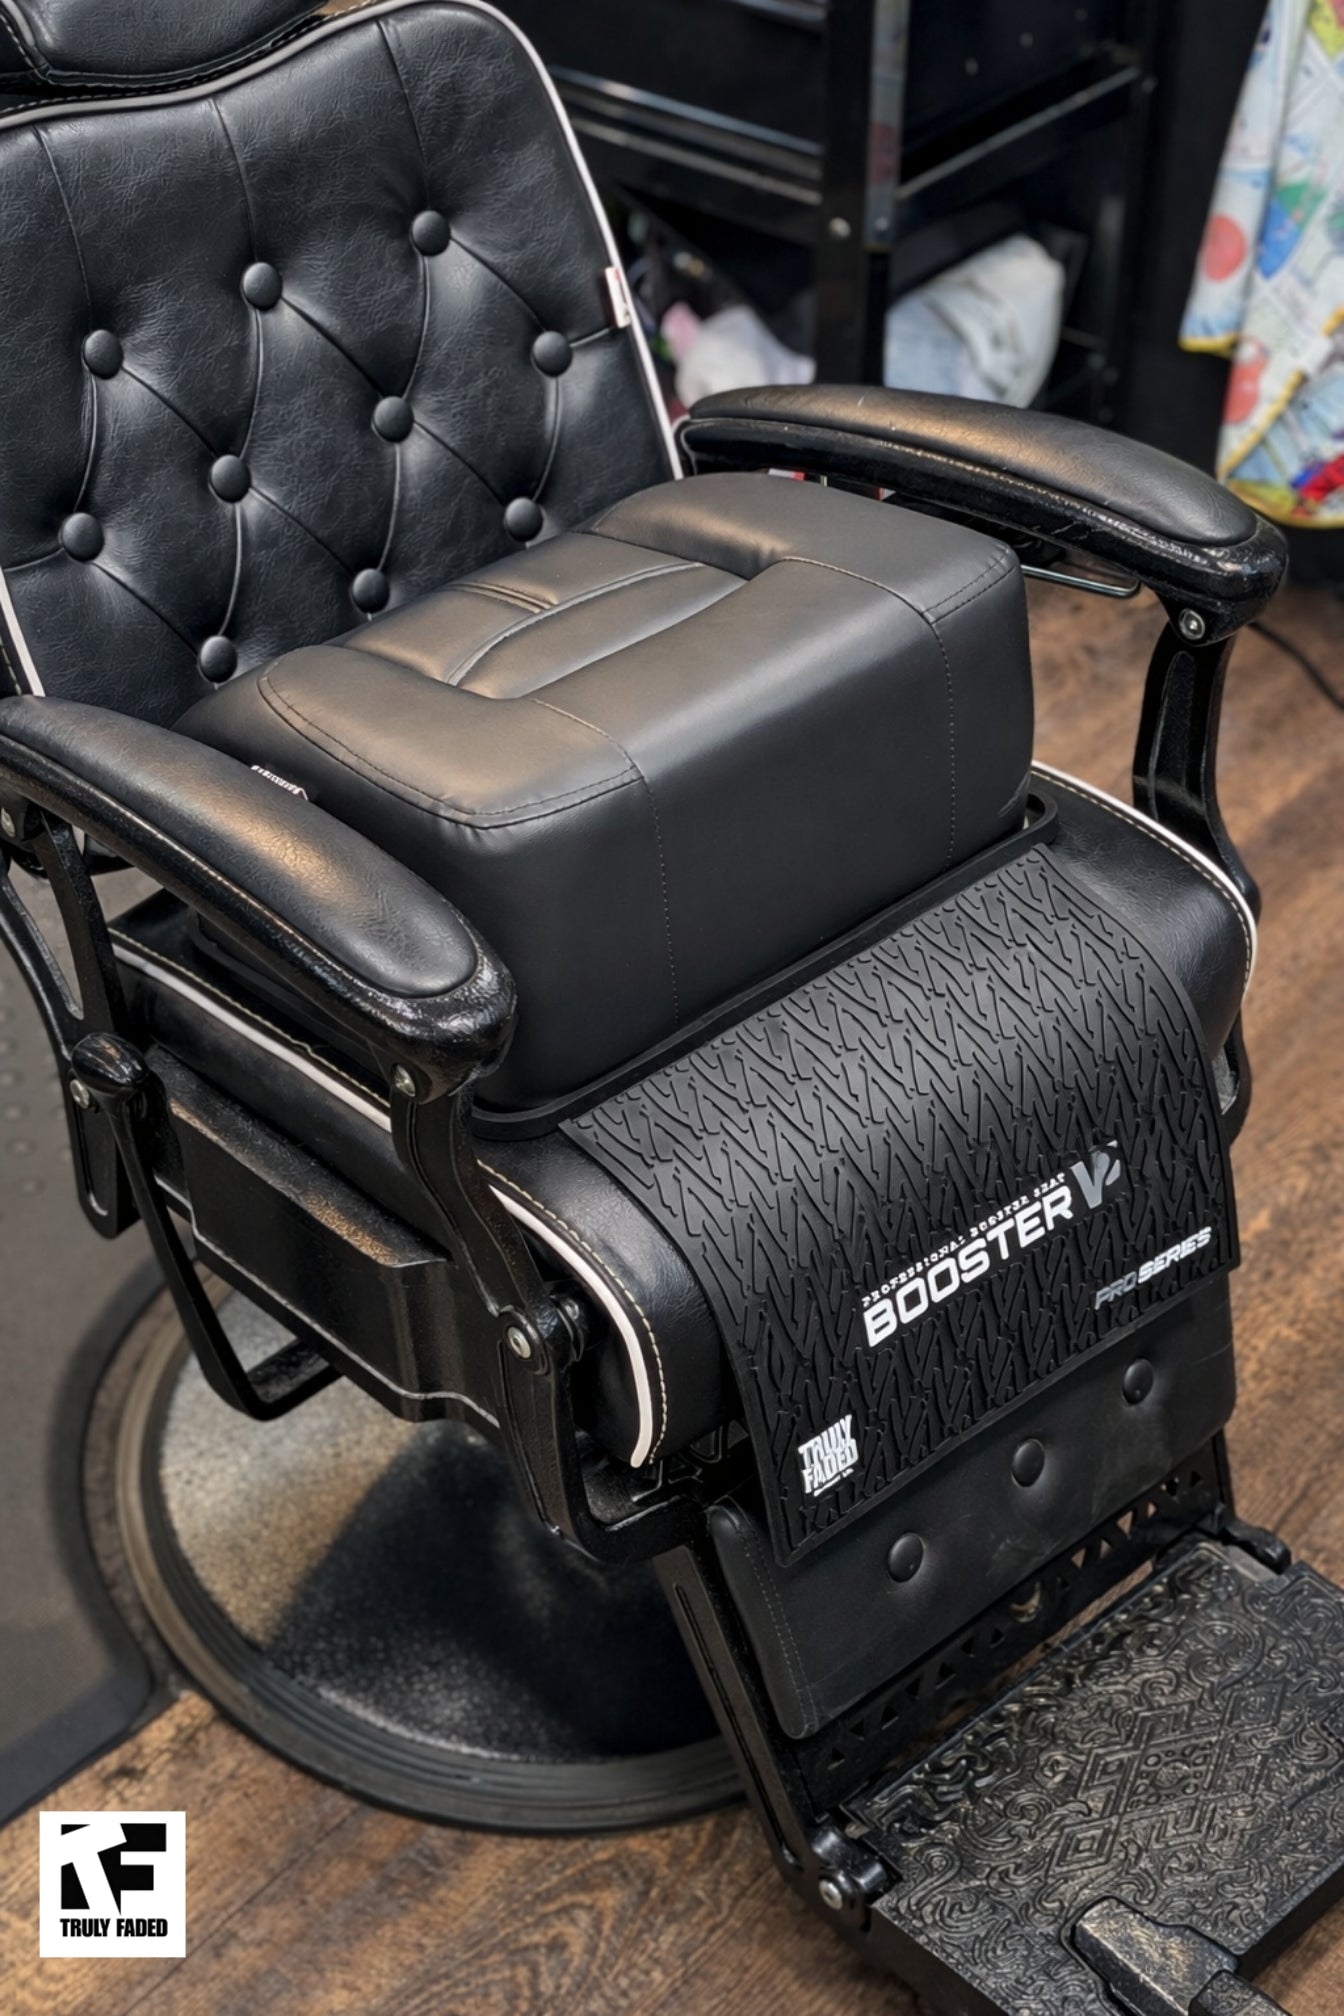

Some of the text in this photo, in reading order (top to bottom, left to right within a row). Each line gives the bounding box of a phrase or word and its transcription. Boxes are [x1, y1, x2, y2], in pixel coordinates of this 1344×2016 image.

[863, 1185, 1074, 1347] BOOSTER
[1138, 1226, 1212, 1284] SERIES
[798, 1414, 853, 1469] TRULY
[801, 1438, 859, 1494] FADED
